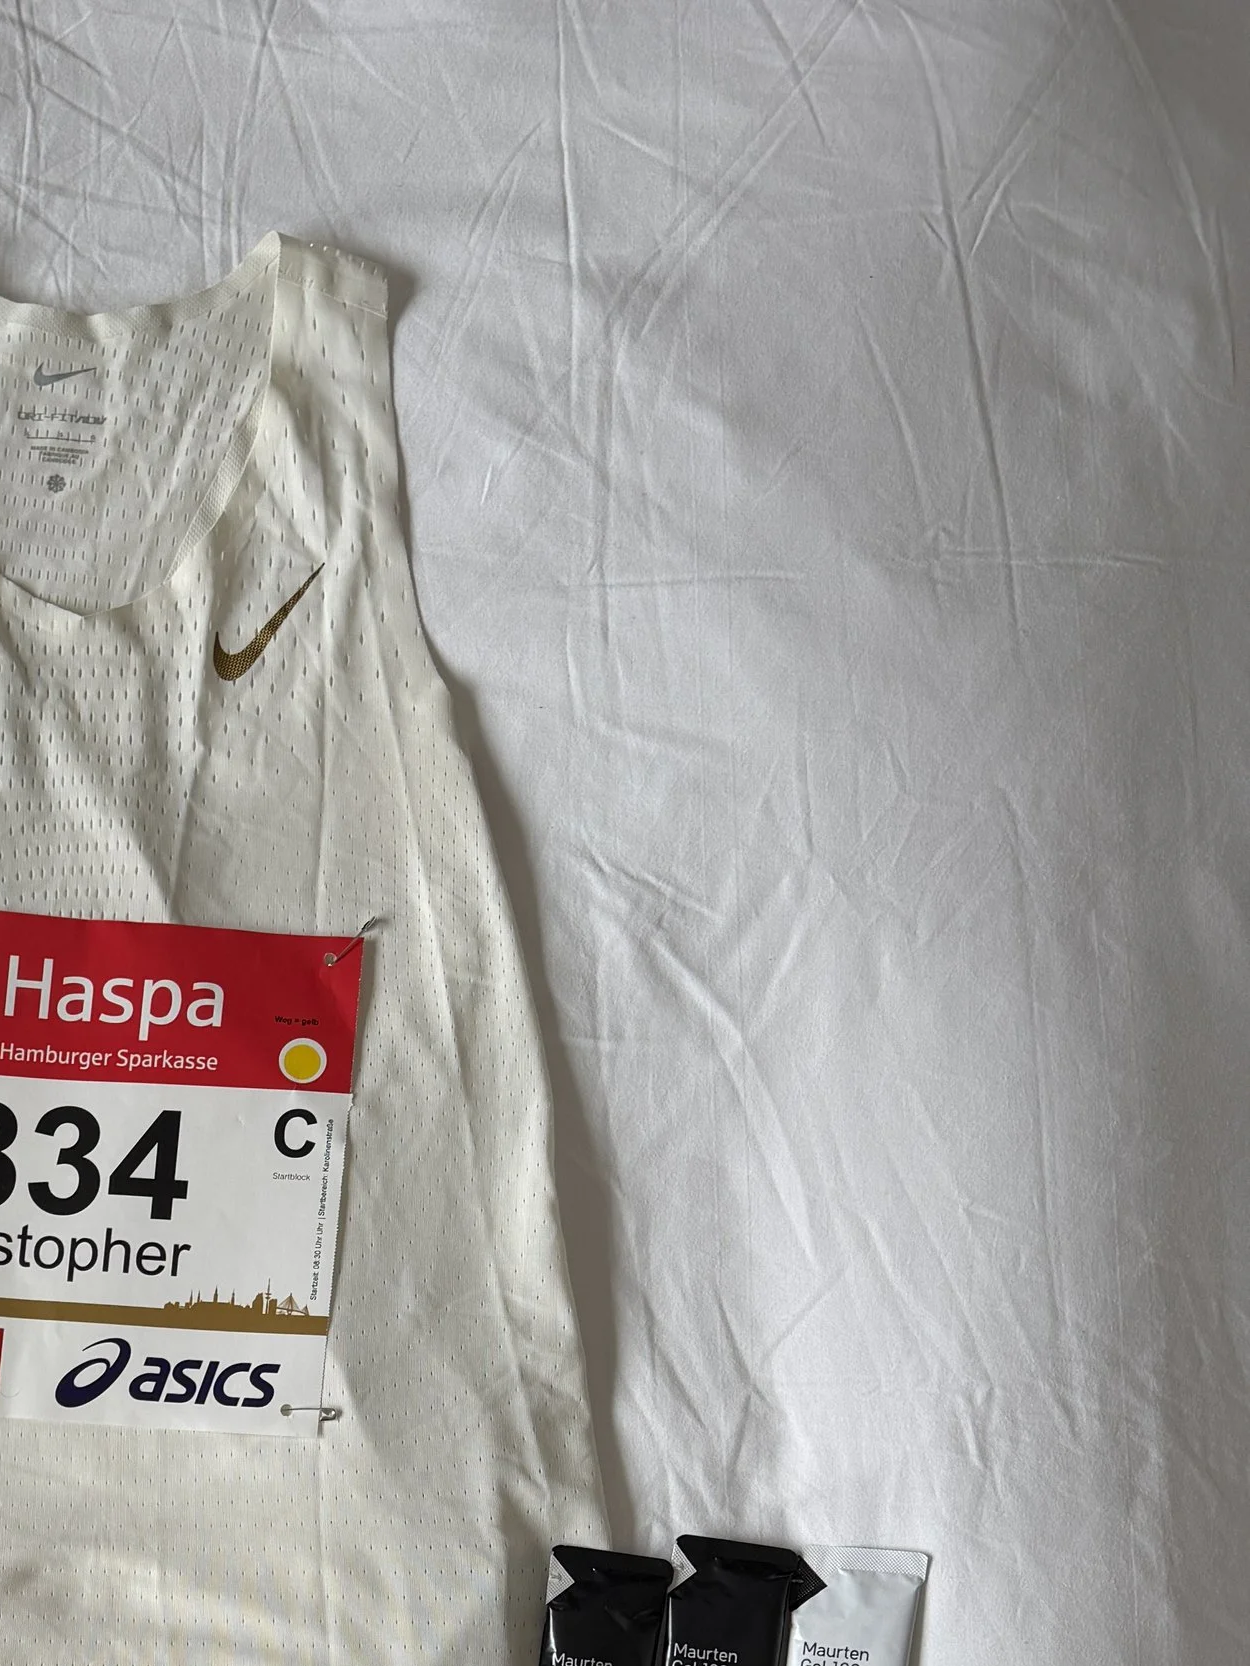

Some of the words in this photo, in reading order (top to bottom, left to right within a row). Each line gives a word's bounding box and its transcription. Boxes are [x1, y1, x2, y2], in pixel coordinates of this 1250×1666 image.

[4, 955, 225, 1041] Haspa
[274, 1015, 293, 1026] Weg
[301, 1018, 319, 1027] gelb
[0, 1042, 113, 1070] Hamburger
[116, 1049, 218, 1071] Sparkasse
[274, 1108, 318, 1159] C
[322, 1118, 334, 1173] Karolinenstraße
[272, 1172, 311, 1182] Startblock
[316, 1222, 325, 1235] Uhr
[315, 1236, 323, 1249] Uhr
[673, 1642, 738, 1664] Maurten
[802, 1641, 870, 1662] Maurten
